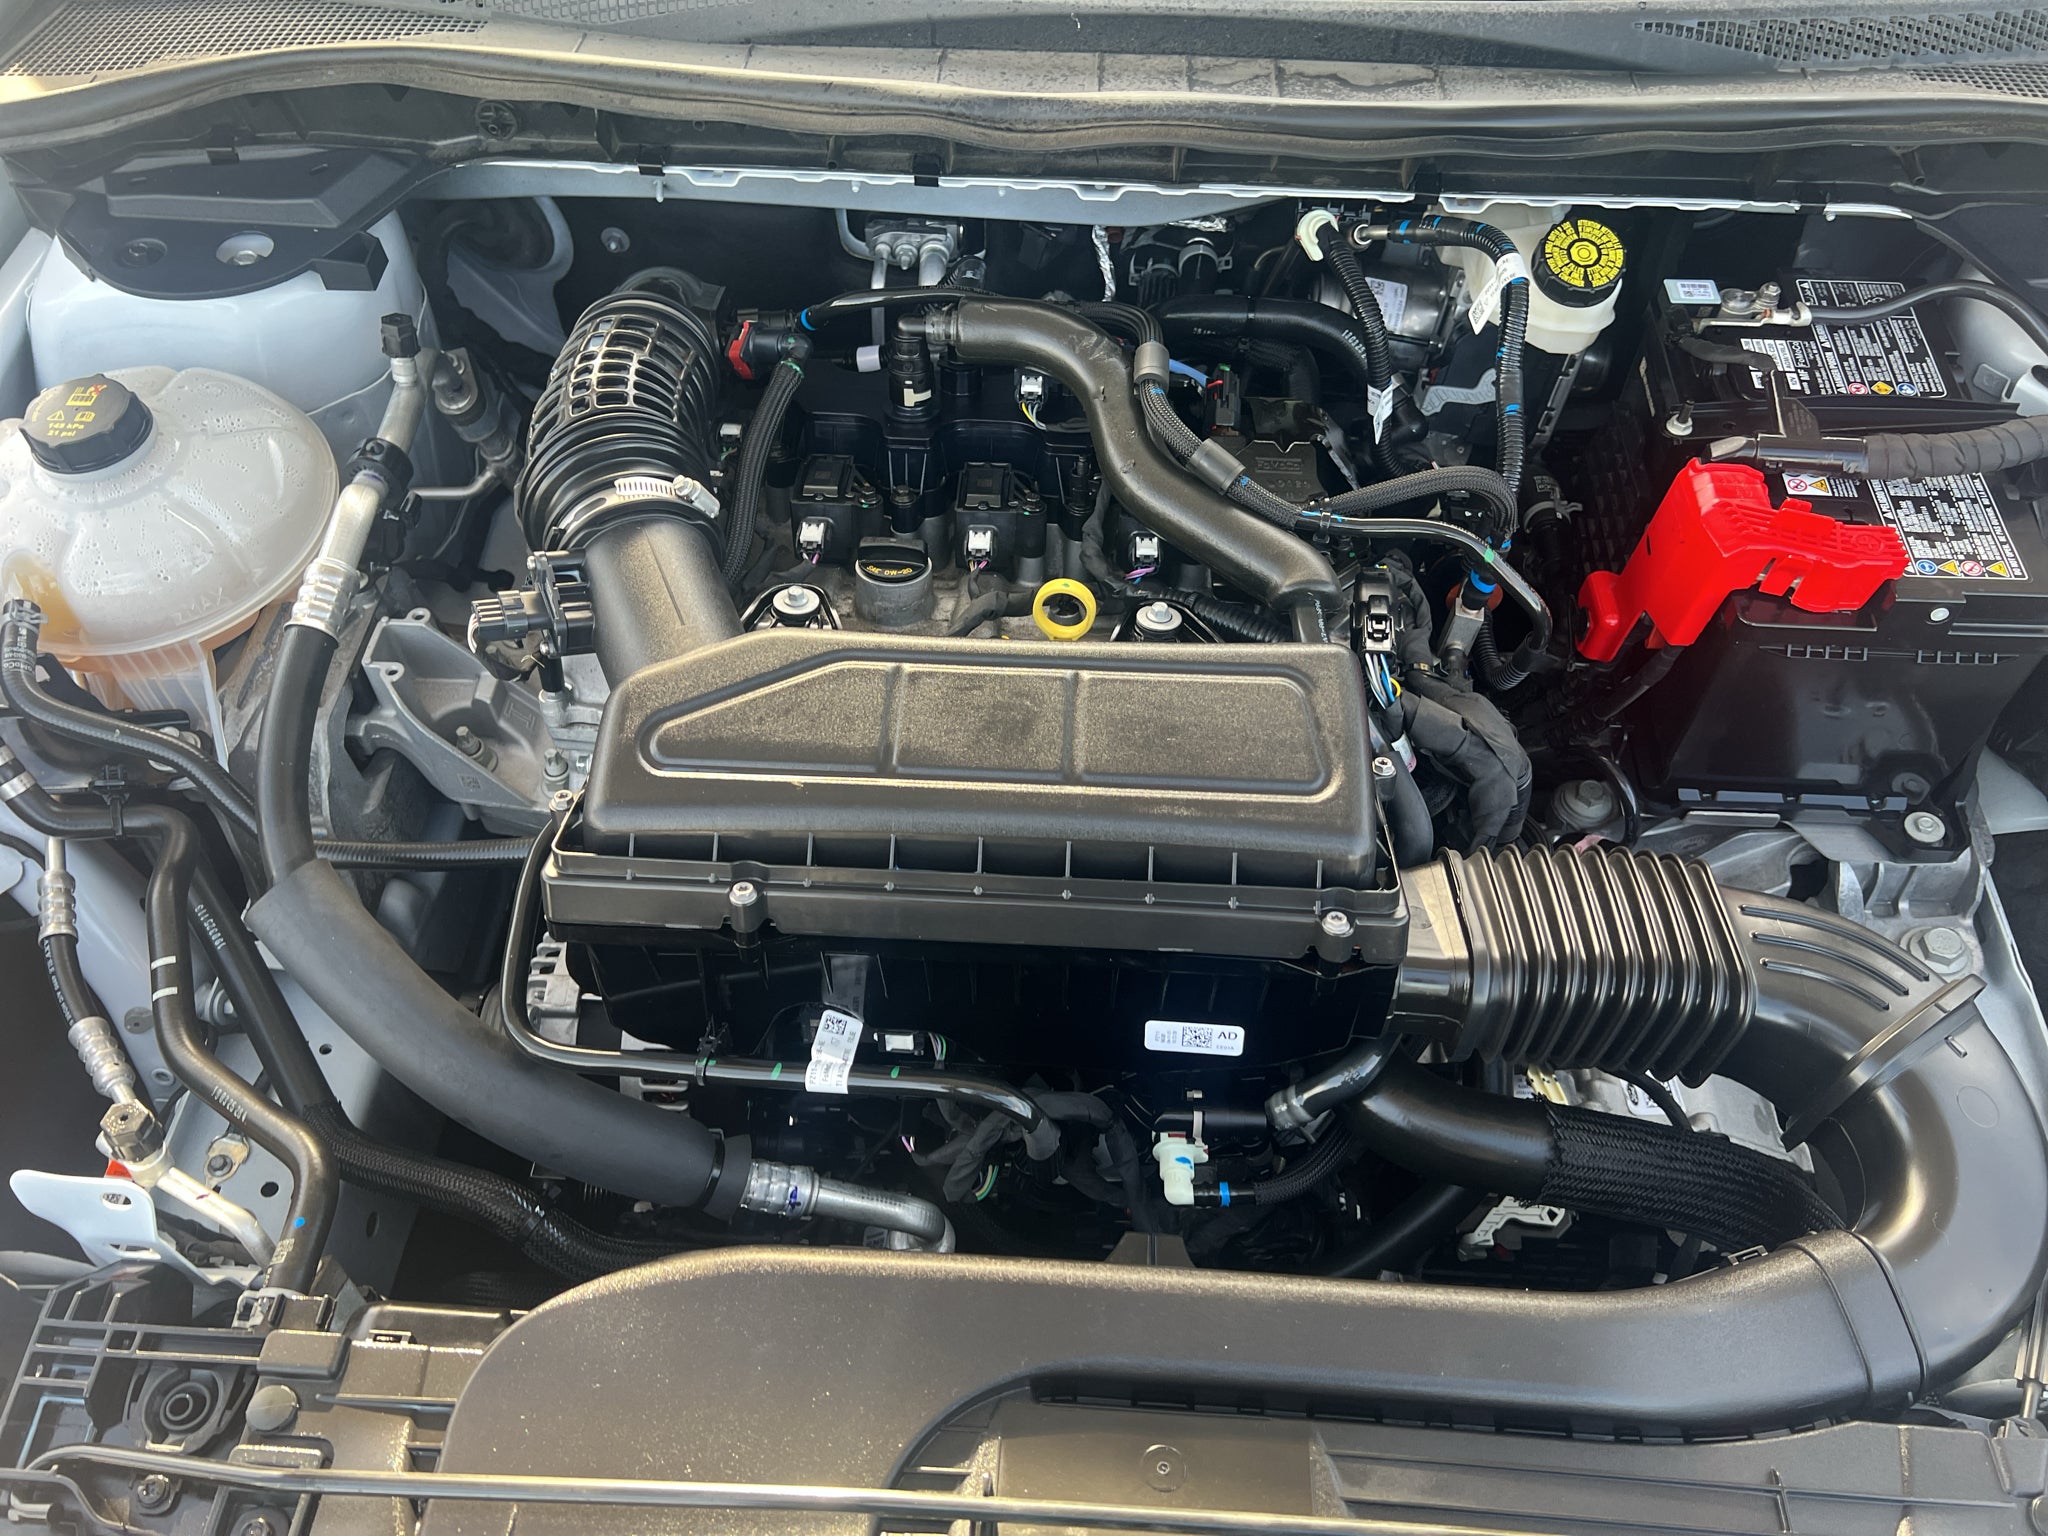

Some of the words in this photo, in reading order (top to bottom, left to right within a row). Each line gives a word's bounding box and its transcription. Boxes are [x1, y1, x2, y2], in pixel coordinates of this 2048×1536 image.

[1791, 341, 1807, 367] FoMoCo
[1797, 367, 1810, 380] MF
[1875, 491, 1891, 512] PELIGRO
[866, 565, 882, 574] SAE
[883, 567, 913, 576] 0W-20
[43, 938, 52, 959] AXY
[1217, 1031, 1238, 1041] AD
